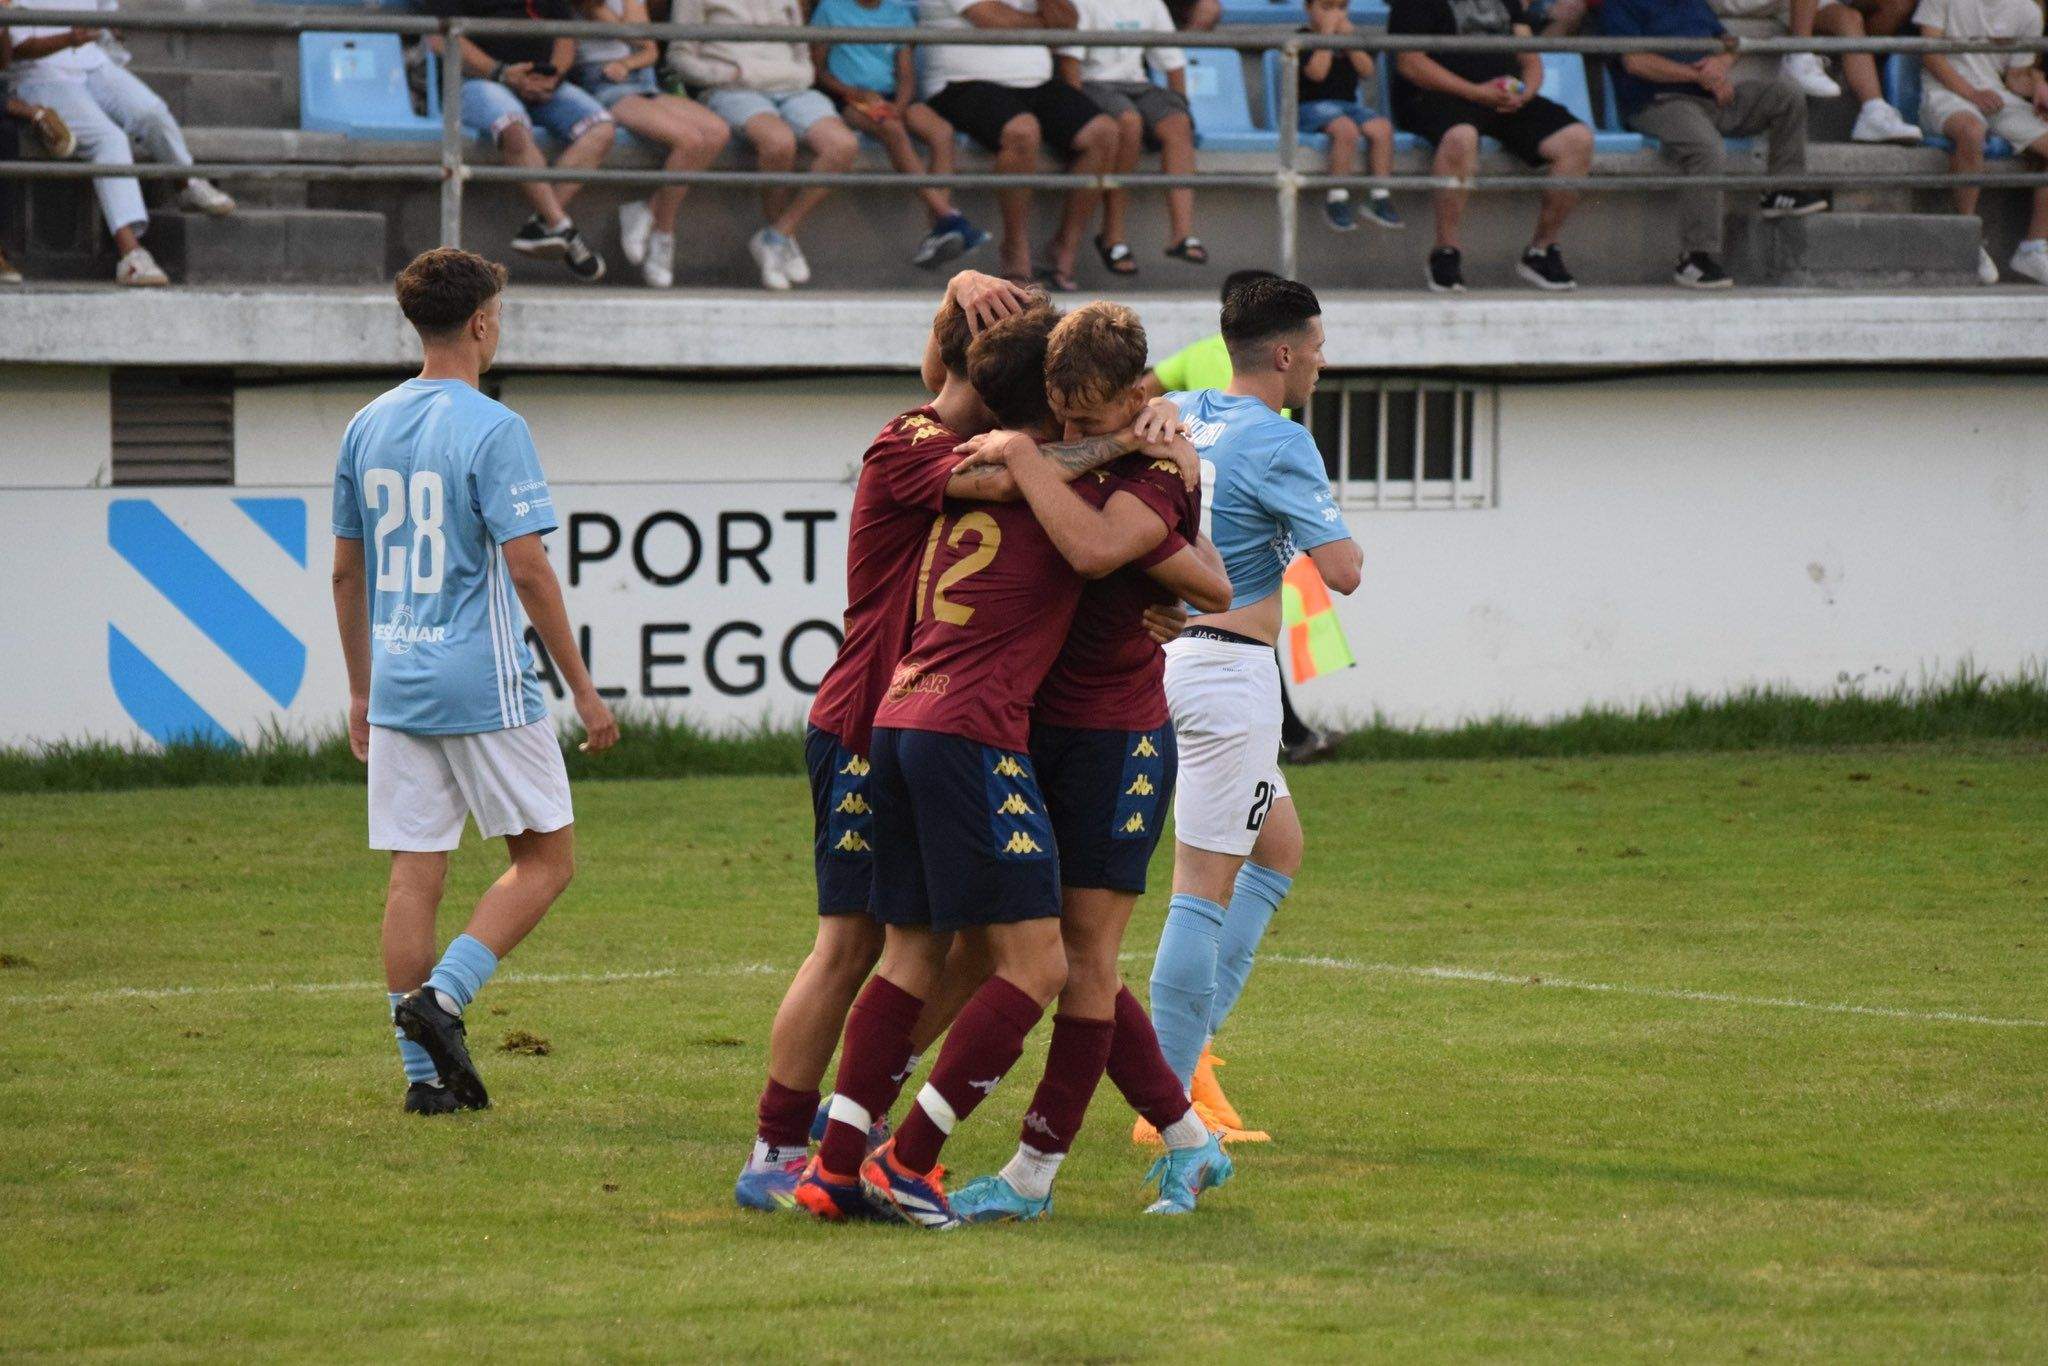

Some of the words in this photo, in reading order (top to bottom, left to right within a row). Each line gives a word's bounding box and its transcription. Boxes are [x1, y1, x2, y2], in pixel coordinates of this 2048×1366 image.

[363, 468, 446, 594] 28
[568, 510, 838, 588] PORT
[915, 511, 1002, 627] 12
[523, 619, 846, 699] ALEGO
